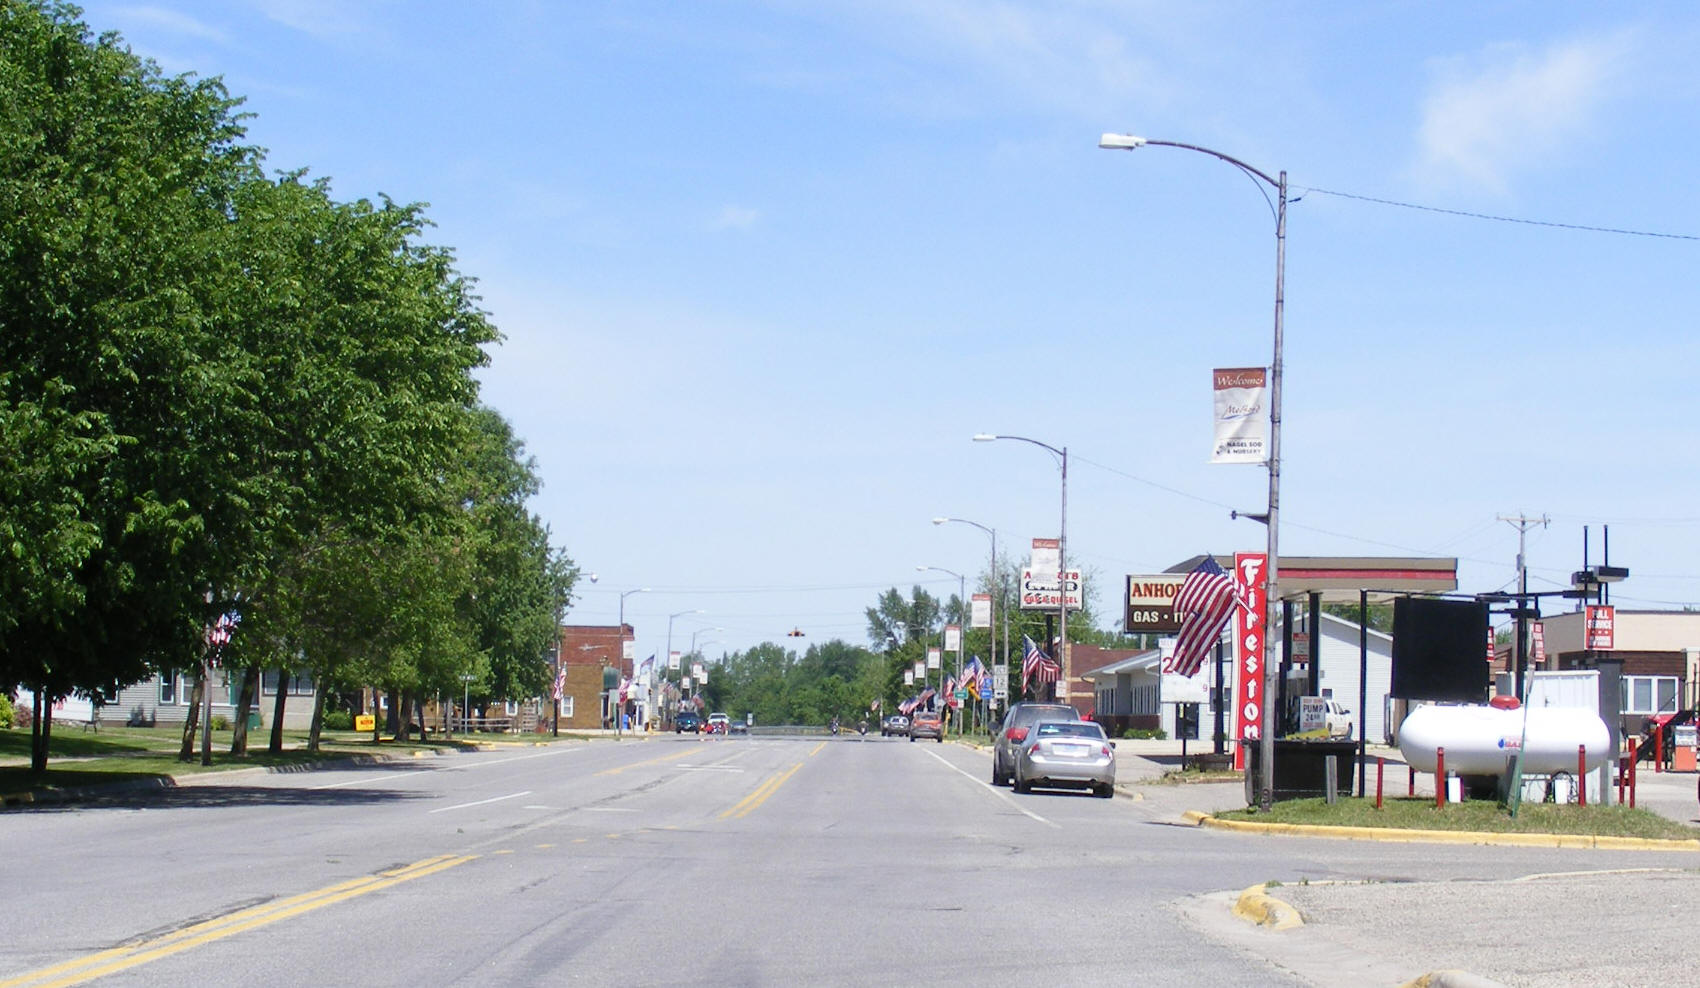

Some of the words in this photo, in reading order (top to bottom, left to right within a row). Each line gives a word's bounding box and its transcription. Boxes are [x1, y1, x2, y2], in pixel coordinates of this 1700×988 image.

[1217, 374, 1263, 386] Welcome
[1133, 611, 1159, 623] GAS
[1239, 558, 1264, 740] Fireston
[1303, 704, 1323, 713] PUMP
